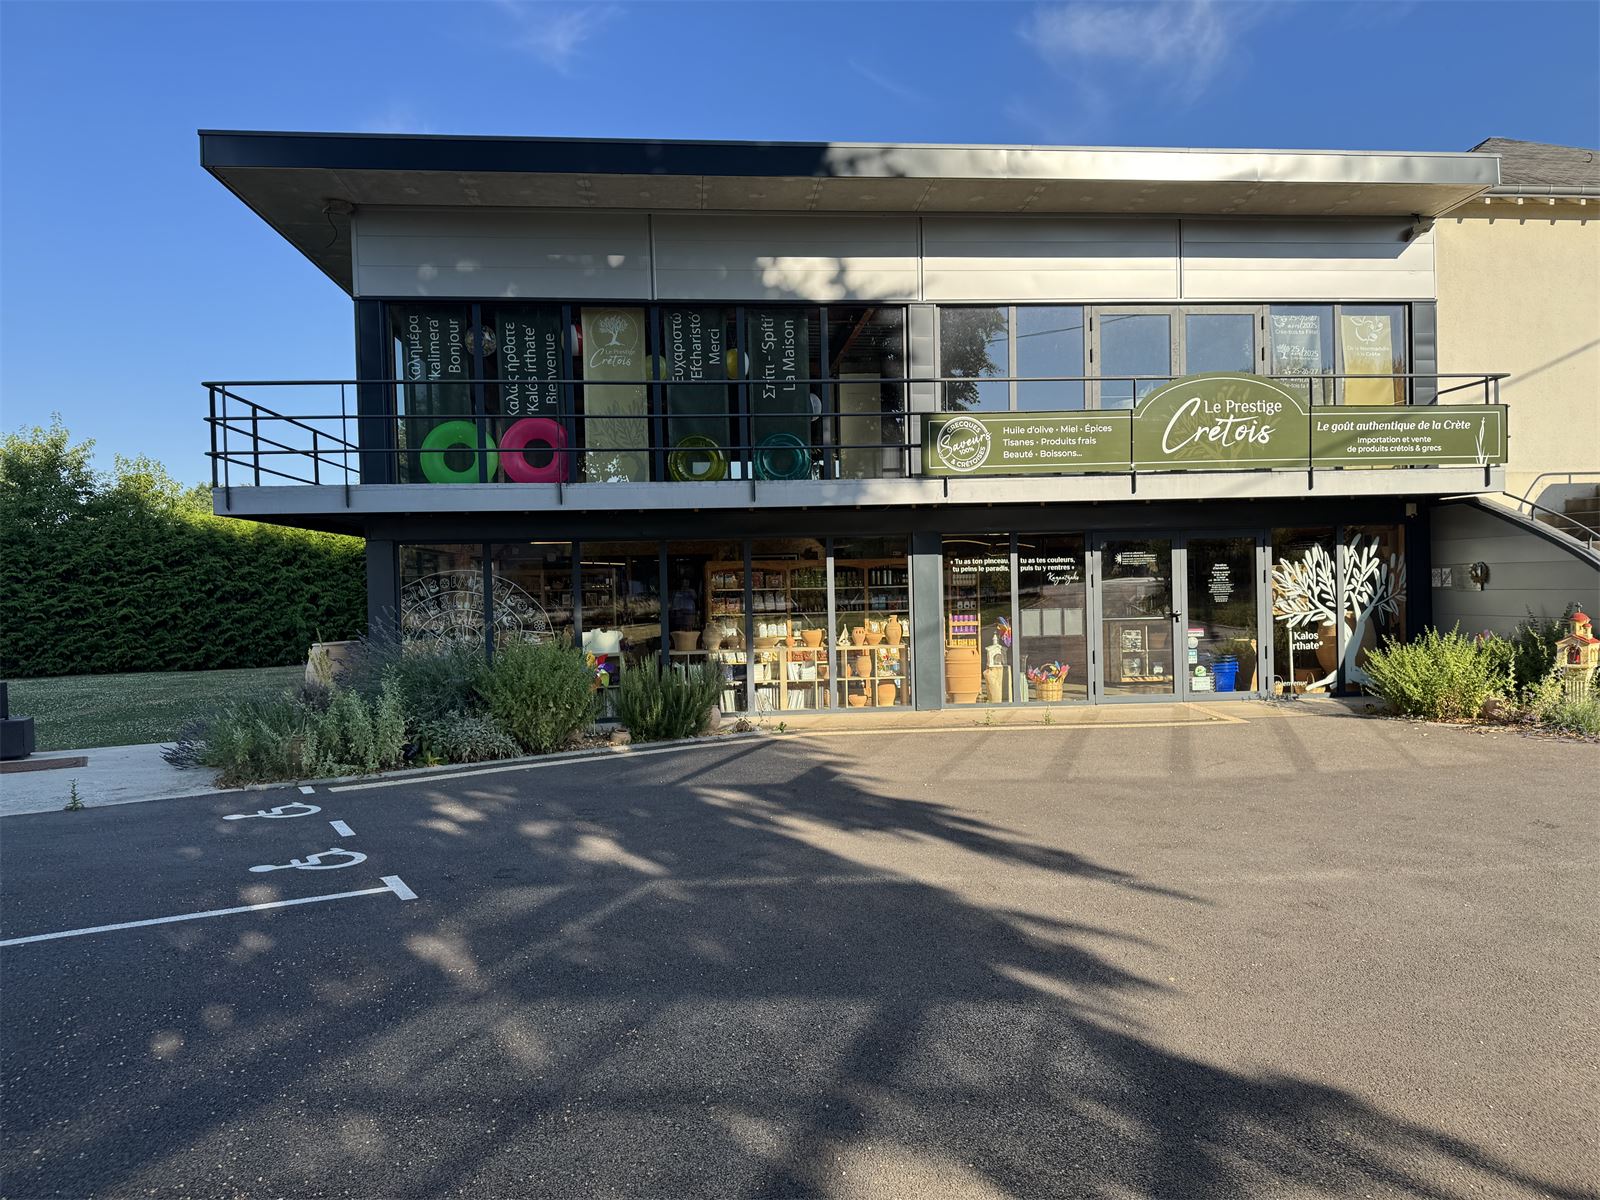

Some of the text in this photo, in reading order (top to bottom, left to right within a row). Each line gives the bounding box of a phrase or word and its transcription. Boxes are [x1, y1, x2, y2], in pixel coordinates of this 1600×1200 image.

[448, 318, 463, 373] Bonjour
[503, 321, 520, 372] ήρθατε
[708, 328, 721, 365] Merci
[782, 320, 796, 391] La Maison
[545, 333, 558, 404] Bienvenue
[1204, 400, 1283, 416] Le Prestige
[947, 420, 981, 434] GRECQUES
[1003, 423, 1113, 434] Huile d'olive Miel Épices
[1162, 397, 1277, 454] Crétois
[1317, 419, 1471, 433] Le goût authentique de la Crète
[939, 432, 992, 459] Saveurs
[1003, 437, 1097, 446] Tisanes Produits frais
[1357, 436, 1401, 444] Importation
[1003, 450, 1034, 459] Beauté
[1346, 445, 1356, 453] de
[1357, 445, 1389, 454] produits
[1389, 444, 1414, 452] crétois
[1422, 444, 1442, 453] grecs
[961, 566, 977, 574] peins
[1020, 564, 1034, 573] puis
[1293, 631, 1319, 640] Kalos
